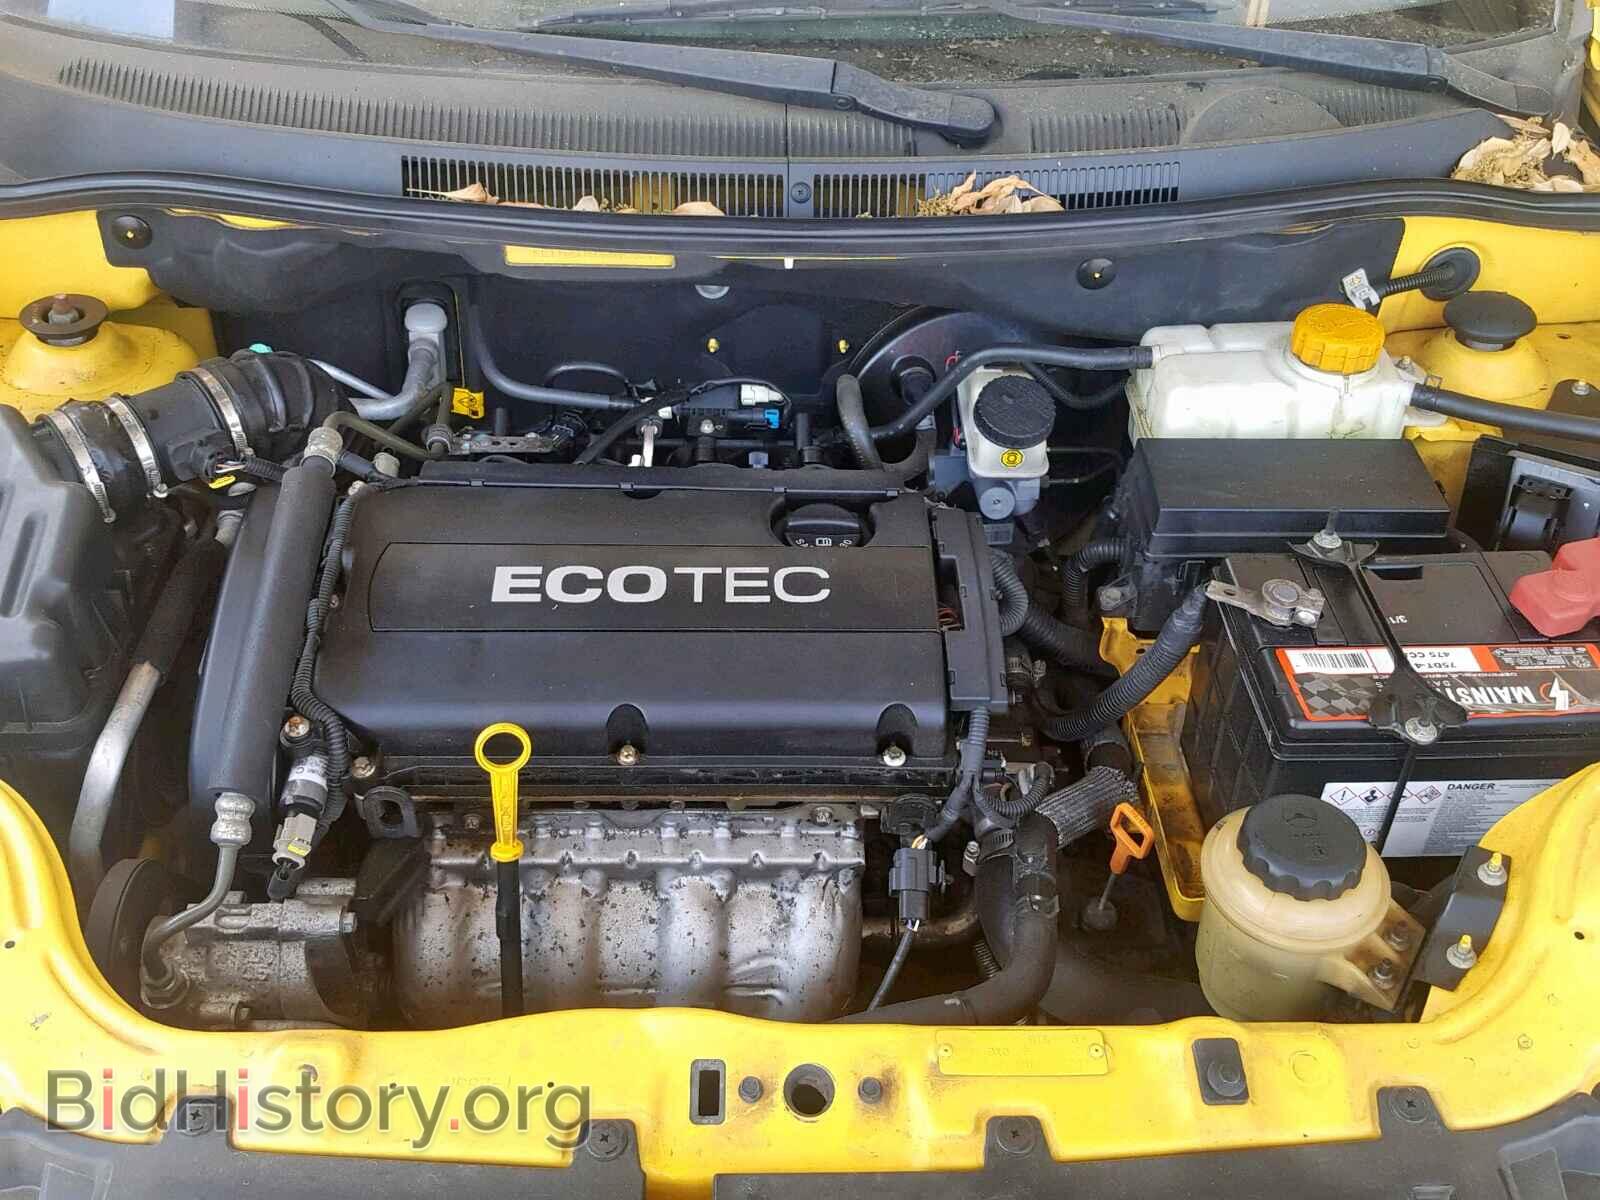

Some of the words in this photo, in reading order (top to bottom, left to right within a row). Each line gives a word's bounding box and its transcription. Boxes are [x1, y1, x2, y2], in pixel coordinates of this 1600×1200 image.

[491, 565, 832, 604] ECOTEC
[1436, 685, 1537, 704] MAINST
[1447, 783, 1496, 791] DANGER
